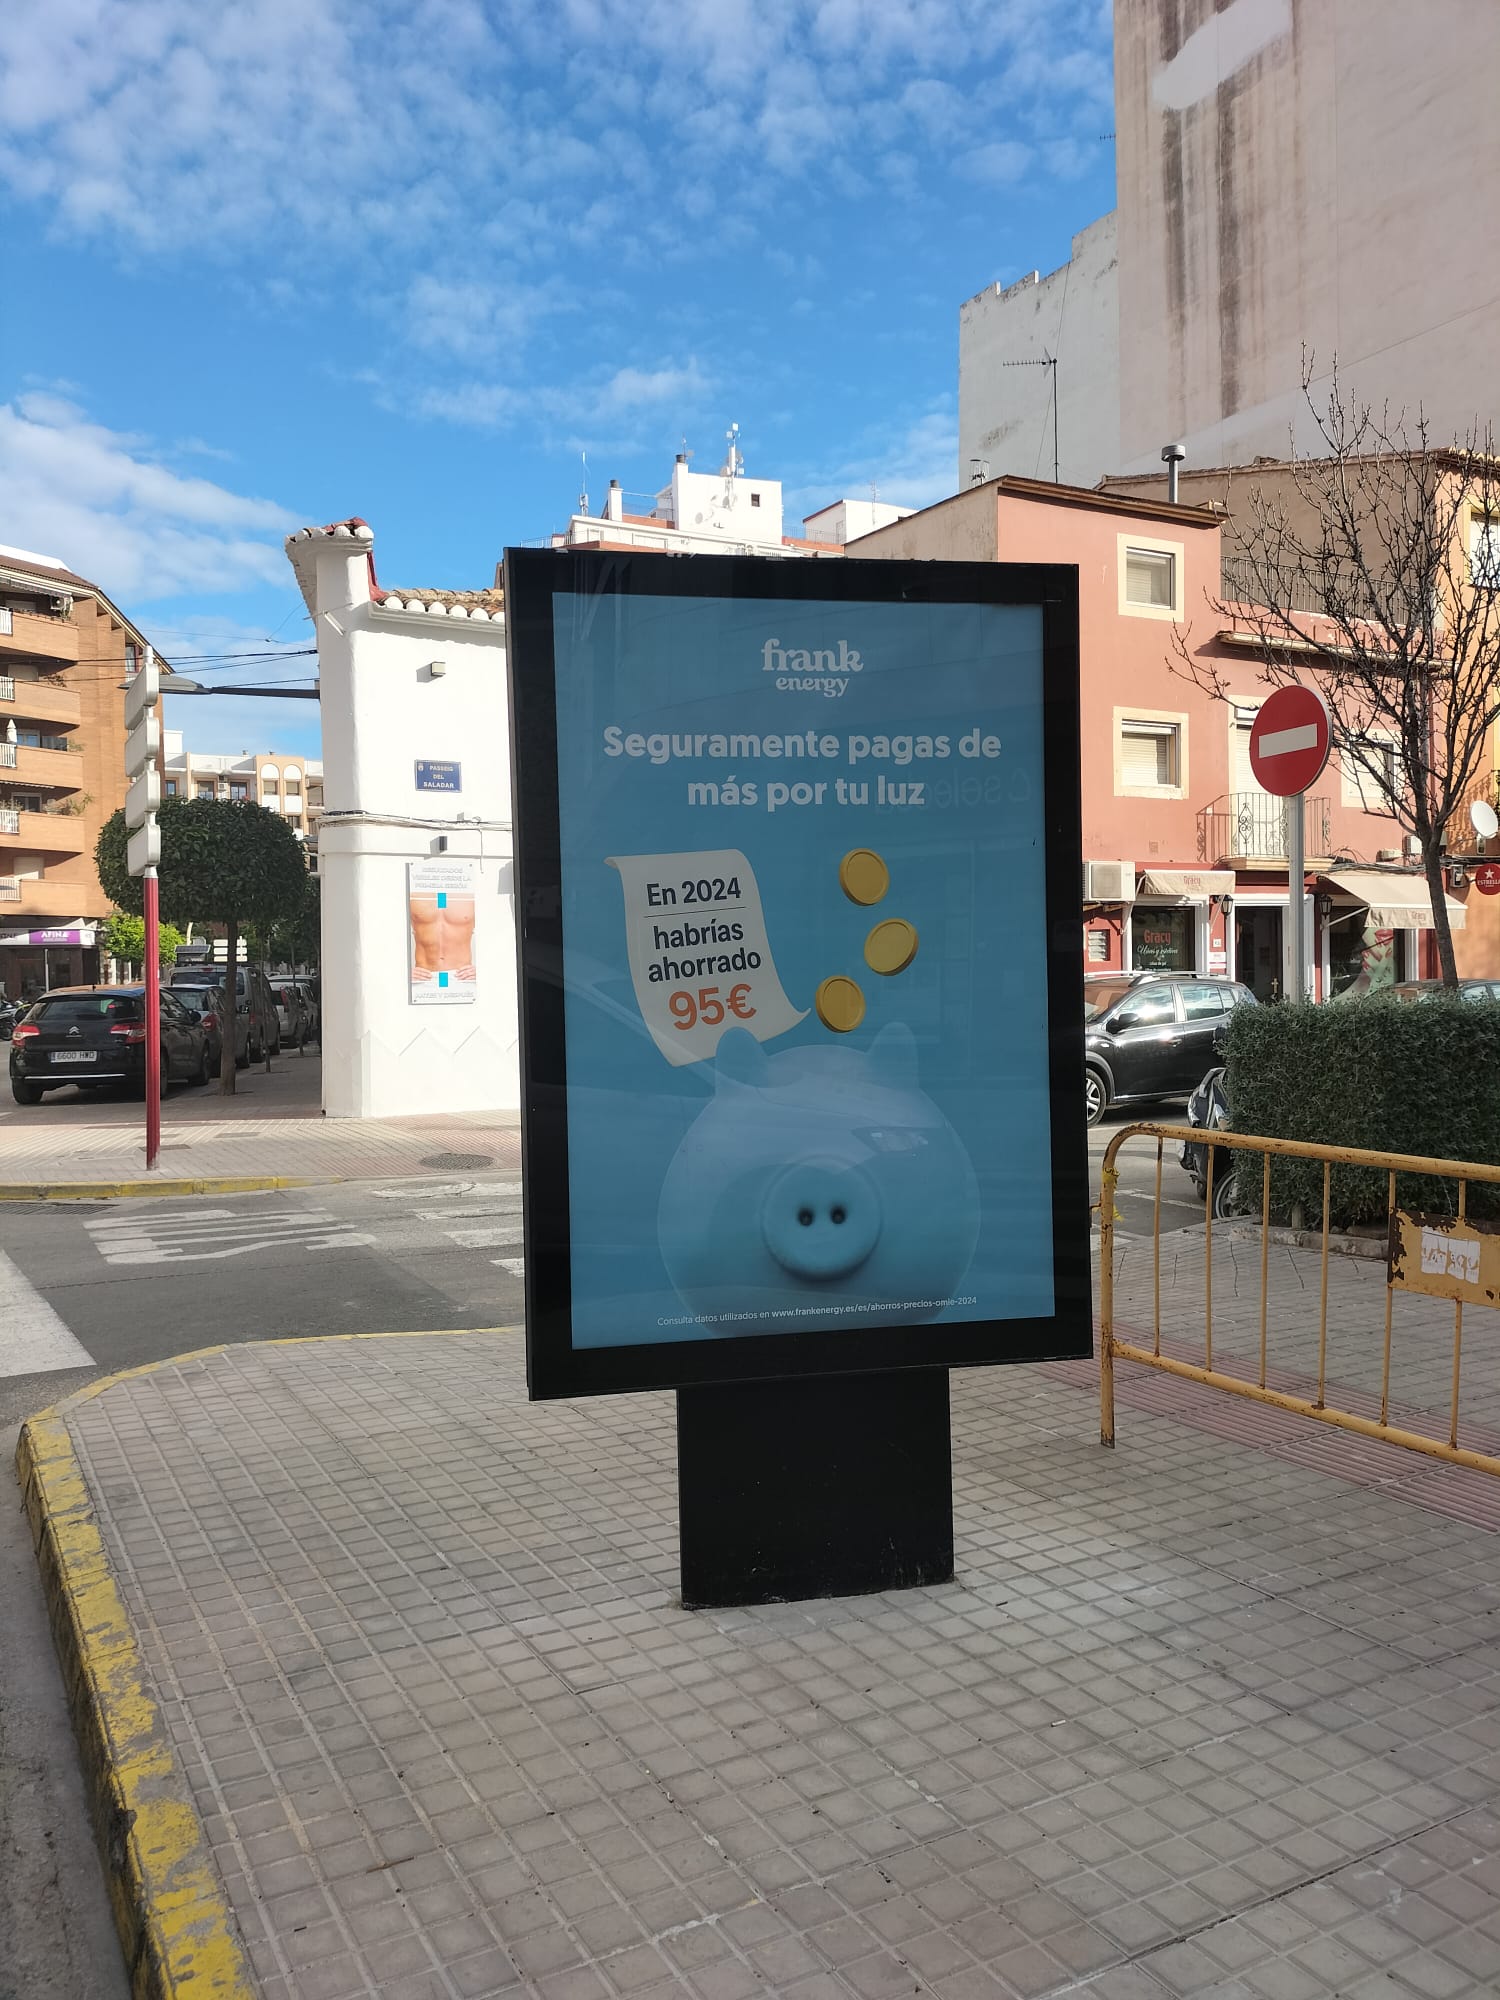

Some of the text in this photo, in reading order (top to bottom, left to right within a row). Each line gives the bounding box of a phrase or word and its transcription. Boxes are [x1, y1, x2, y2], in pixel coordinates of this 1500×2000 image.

[762, 638, 865, 673] frank
[775, 677, 850, 698] energy
[602, 726, 1002, 765] Seguramente pagas de
[423, 781, 455, 789] SALADAR
[688, 774, 926, 812] más por tu luz
[646, 877, 741, 907] En 2024
[653, 918, 745, 950] habrías
[1144, 929, 1171, 945] Gracy
[648, 947, 762, 983] ahorrado
[668, 983, 758, 1031] 95€
[656, 1316, 693, 1326] Consulta
[694, 1314, 718, 1323] datos
[719, 1311, 758, 1321] utilizados
[759, 1311, 770, 1319] en
